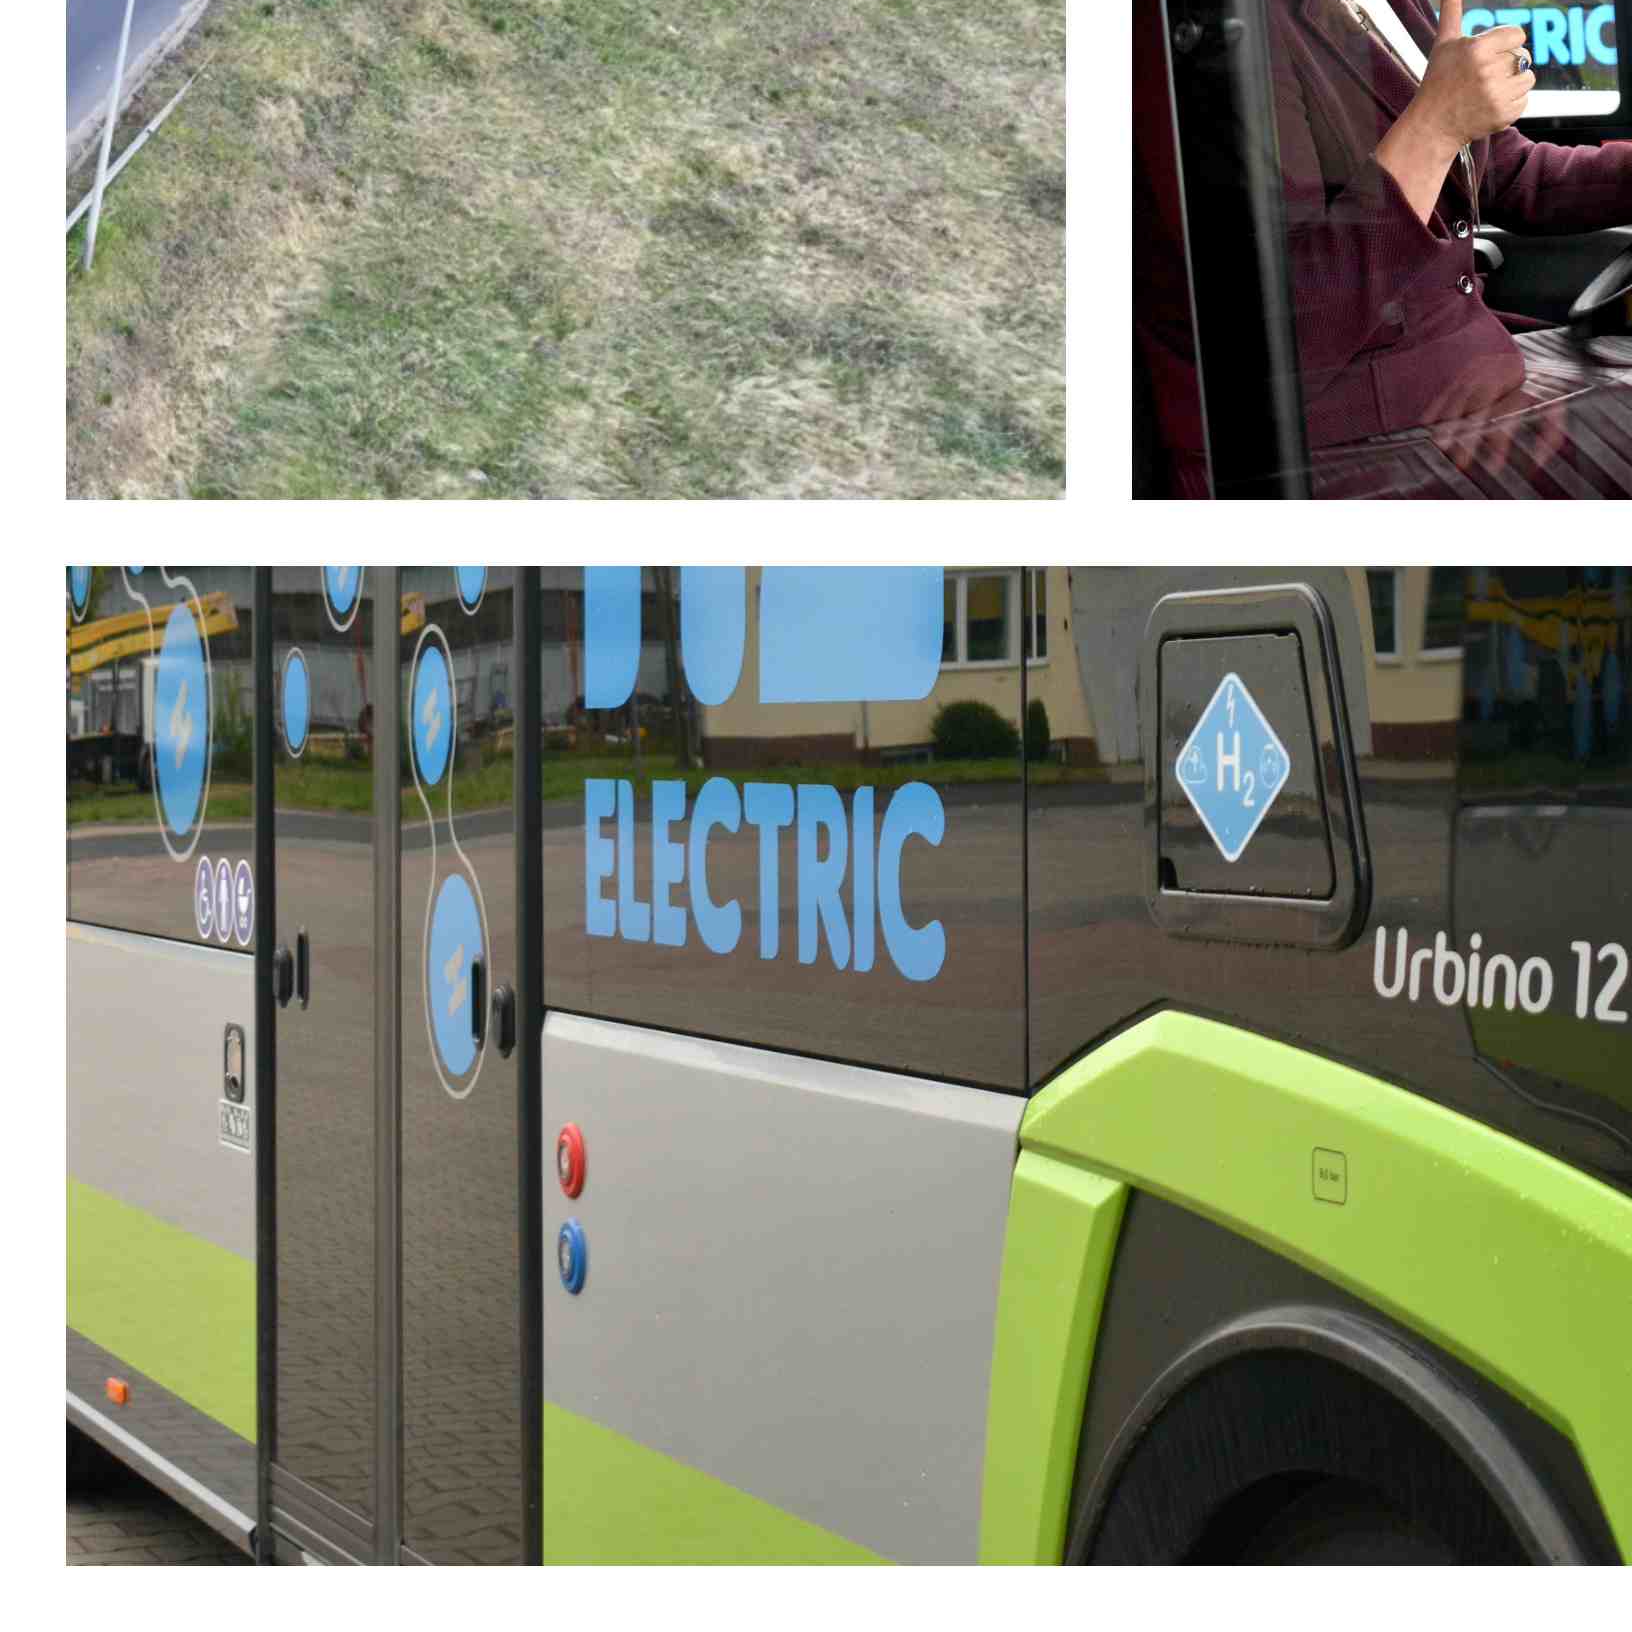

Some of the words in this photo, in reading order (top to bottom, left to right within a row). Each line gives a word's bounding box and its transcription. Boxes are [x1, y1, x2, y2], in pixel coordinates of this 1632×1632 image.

[585, 776, 946, 982] ELECTRIC
[1374, 926, 1553, 1013] Urbino
[1571, 941, 1629, 1023] 12
